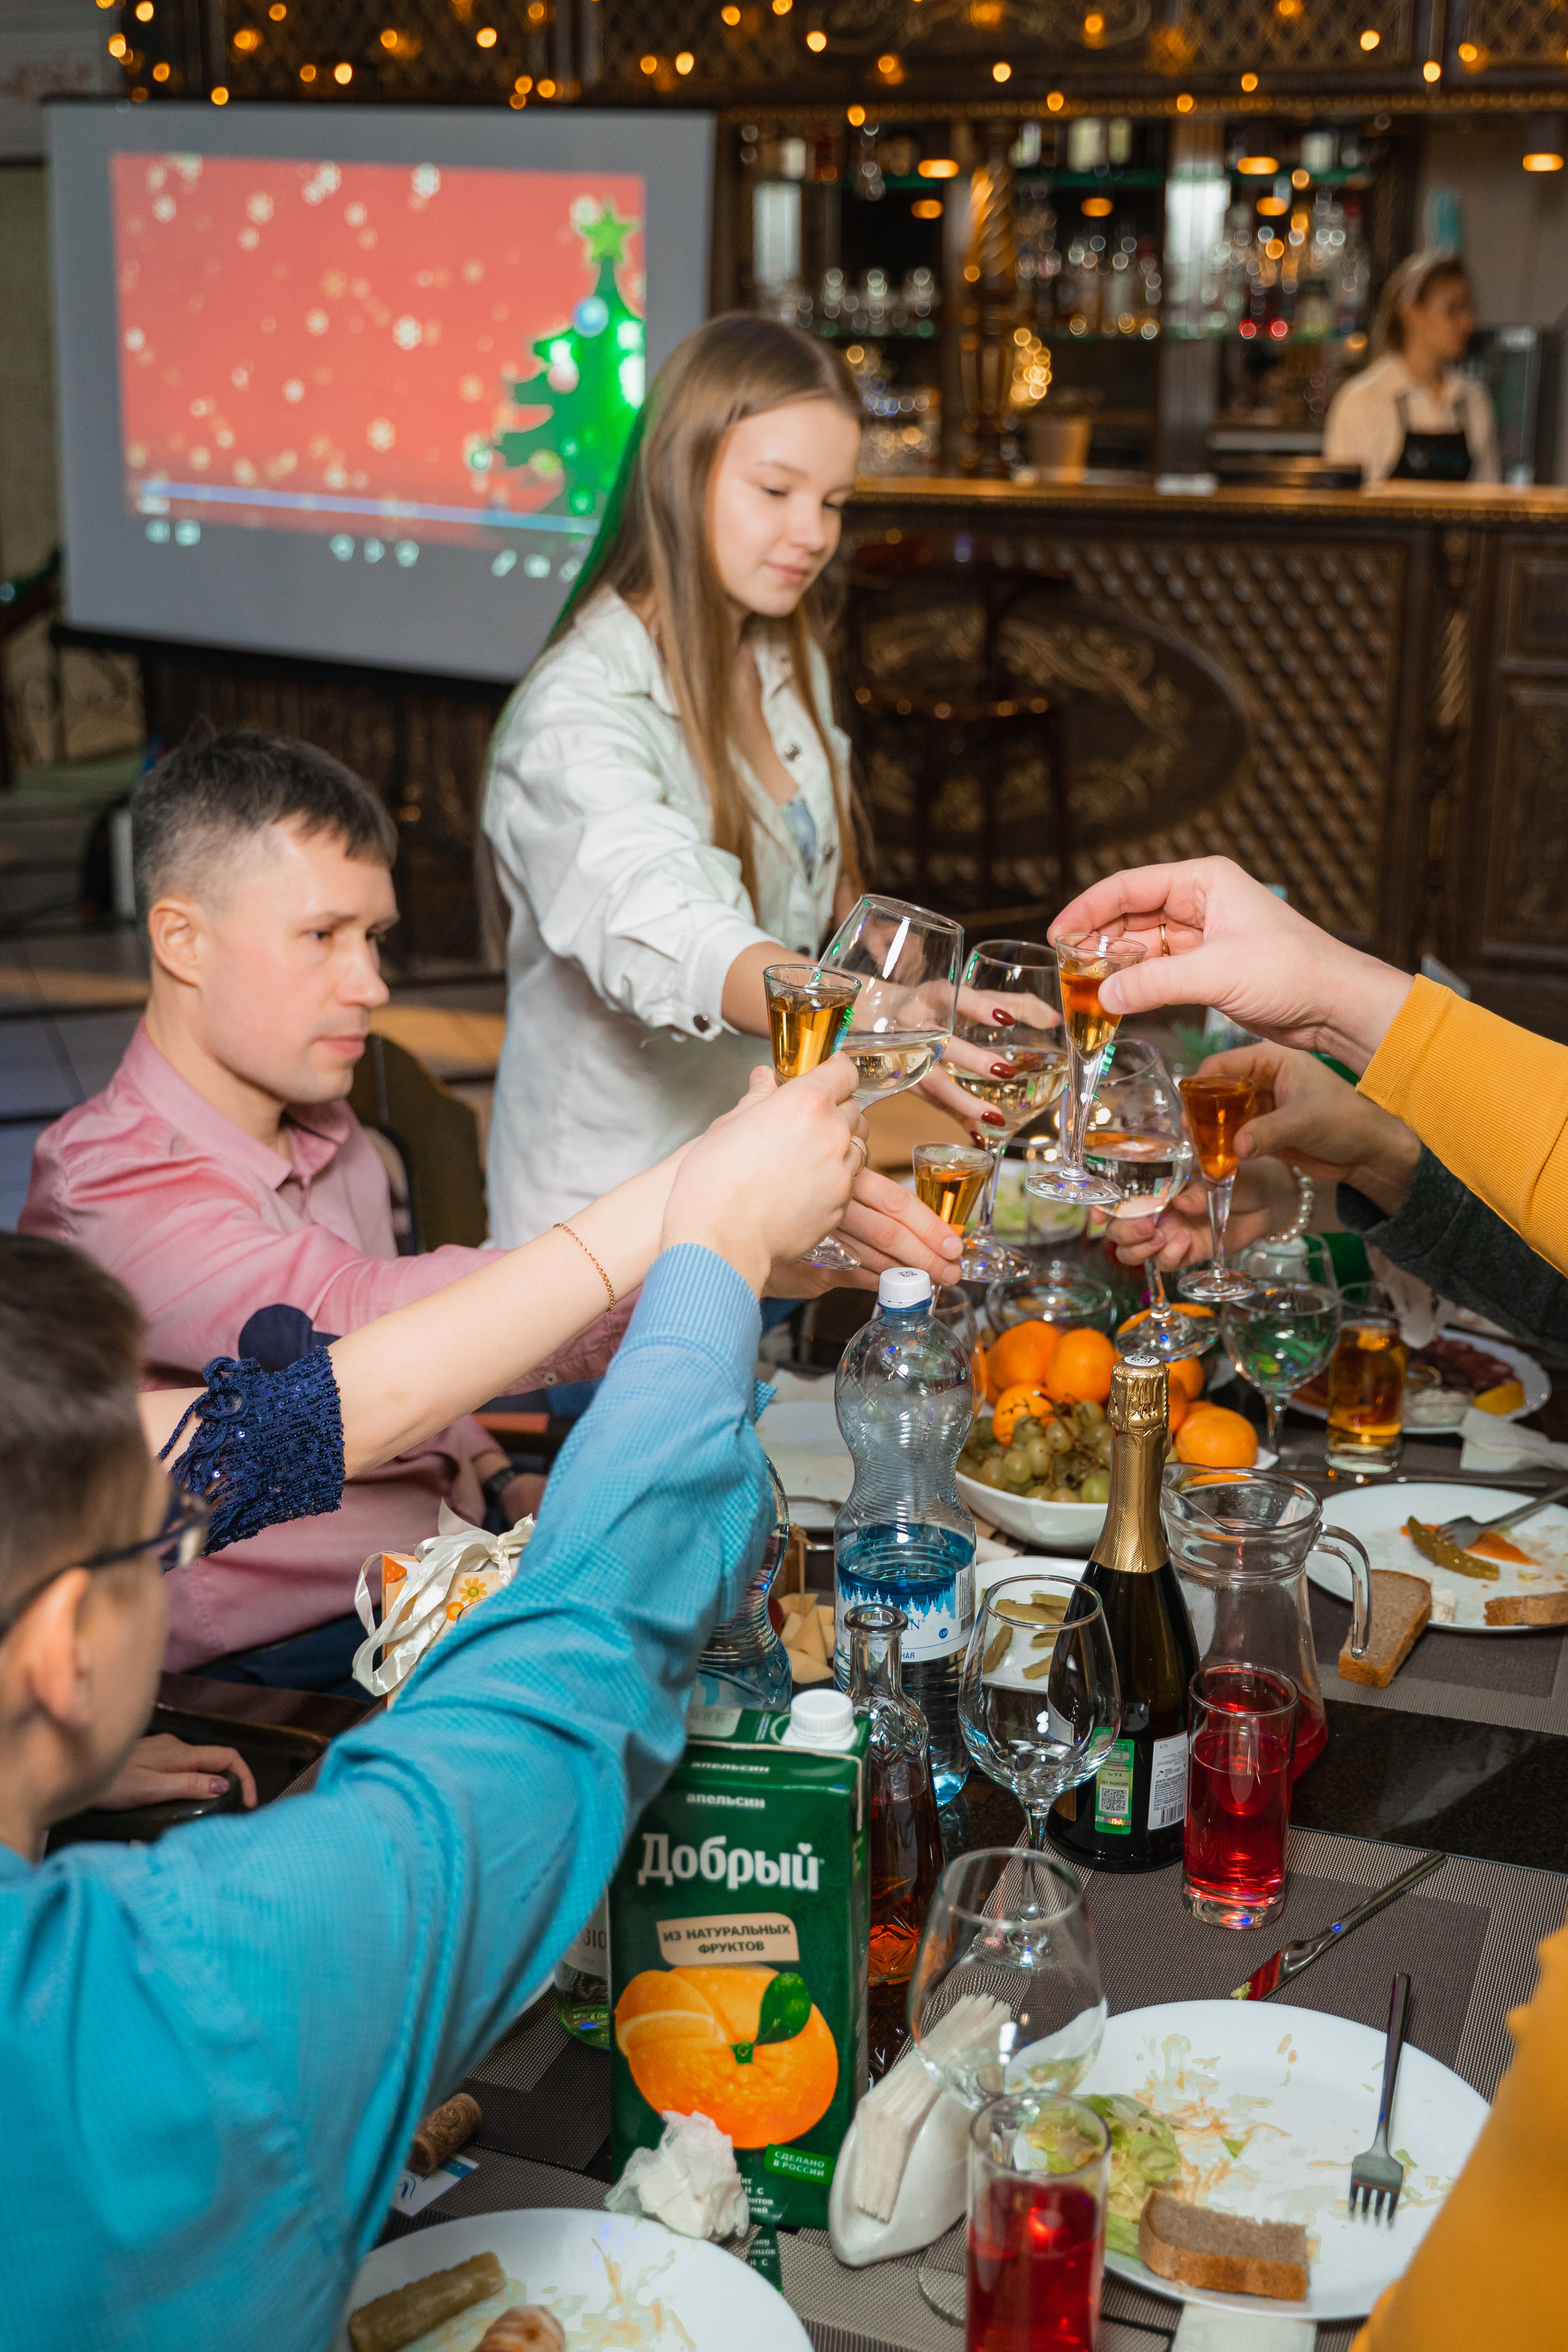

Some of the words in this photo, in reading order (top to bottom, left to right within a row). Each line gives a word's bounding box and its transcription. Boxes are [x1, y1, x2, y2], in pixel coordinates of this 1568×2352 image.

[691, 1761, 771, 1774] апельсин
[686, 1792, 766, 1810] апельсин
[638, 1833, 819, 1892] Добрый
[663, 1930, 682, 1942] ИЗ
[686, 1924, 791, 1940] НАТУРАЛЬНЫХ
[698, 1940, 765, 1954] ФРУКТОВ
[774, 2150, 825, 2168] СДЕЛАНО
[782, 2161, 824, 2177] РОССИИ
